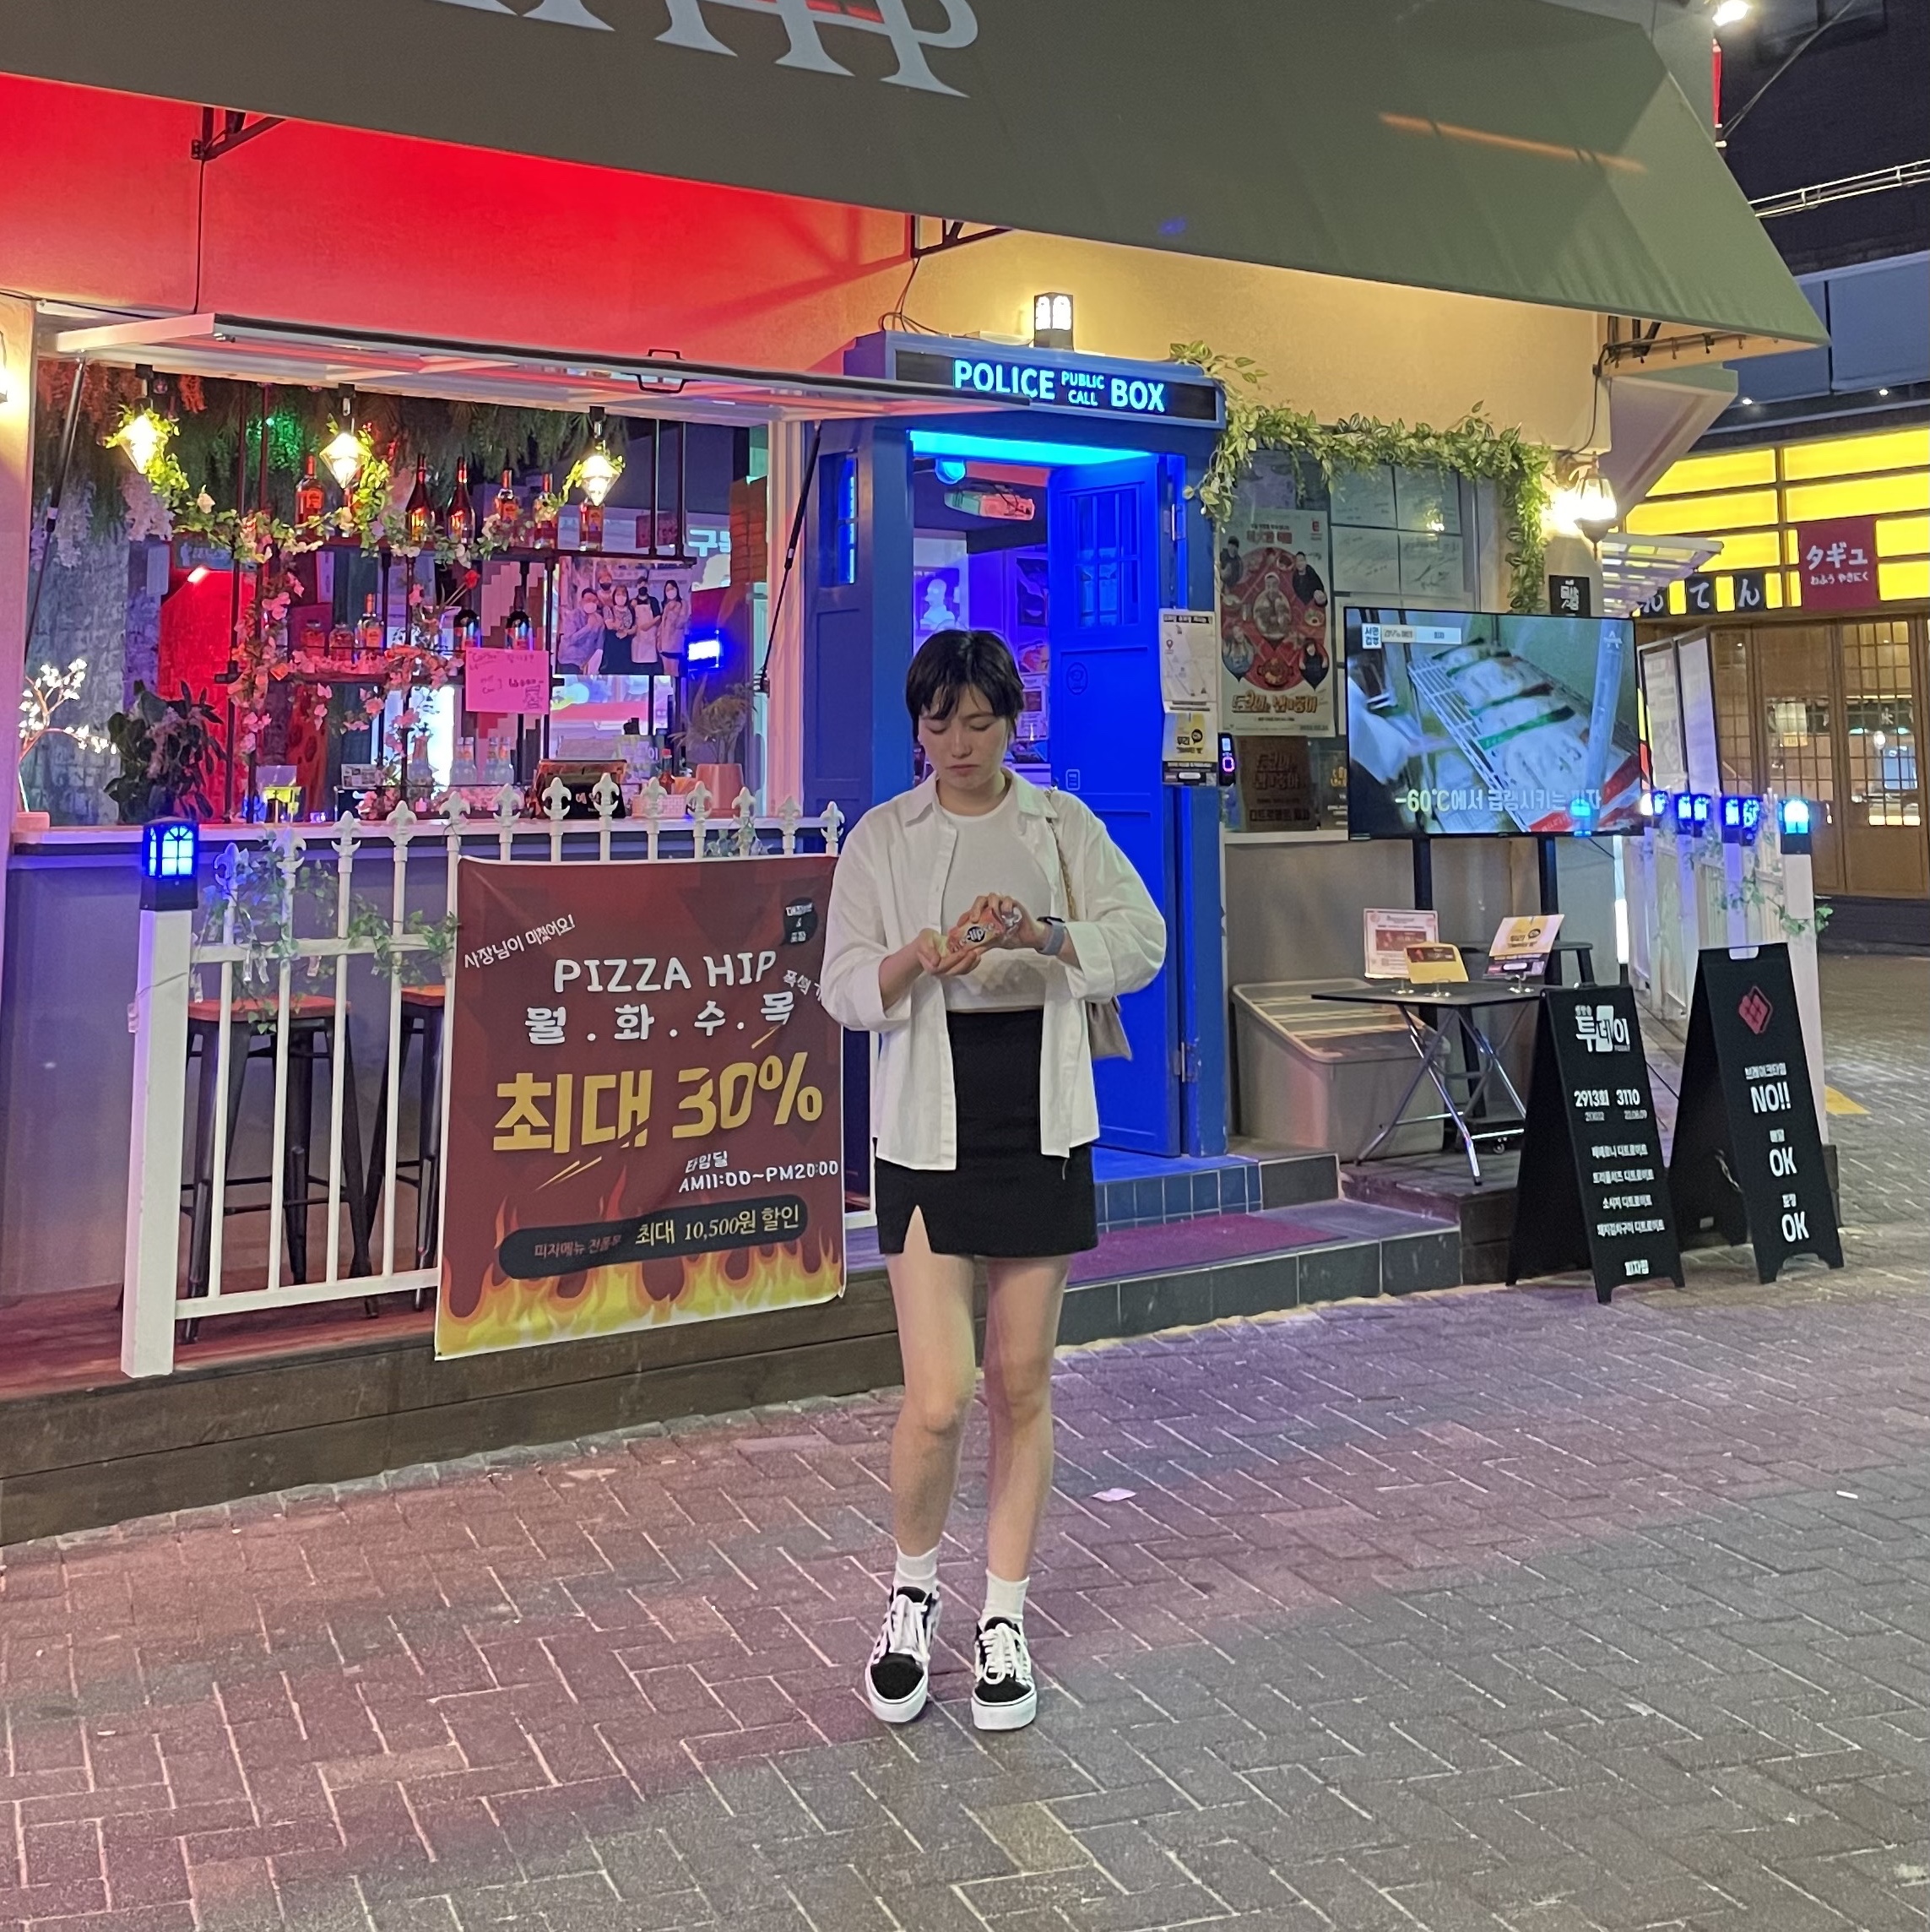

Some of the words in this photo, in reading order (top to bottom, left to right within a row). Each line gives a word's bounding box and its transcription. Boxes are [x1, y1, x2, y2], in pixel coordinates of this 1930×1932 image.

[953, 359, 1055, 399] POLICE
[1060, 371, 1105, 390] PUBLIC
[1110, 377, 1166, 413] BOX
[1068, 389, 1098, 406] CALL
[1806, 541, 1868, 570] タギュ
[464, 936, 525, 969] 사장님이
[525, 914, 576, 945] 미쳤어요!
[554, 957, 692, 994] PIZZA
[702, 950, 777, 988] HIP
[492, 1069, 653, 1153] 최대
[671, 1051, 823, 1140] 30%
[1750, 1081, 1792, 1114] NO!!
[685, 1151, 728, 1174] 타임딜
[1769, 1147, 1798, 1177] OK
[635, 1219, 676, 1247] 최대
[683, 1210, 757, 1241] 10,500원
[761, 1204, 800, 1232] 할인
[1781, 1211, 1810, 1242] OK
